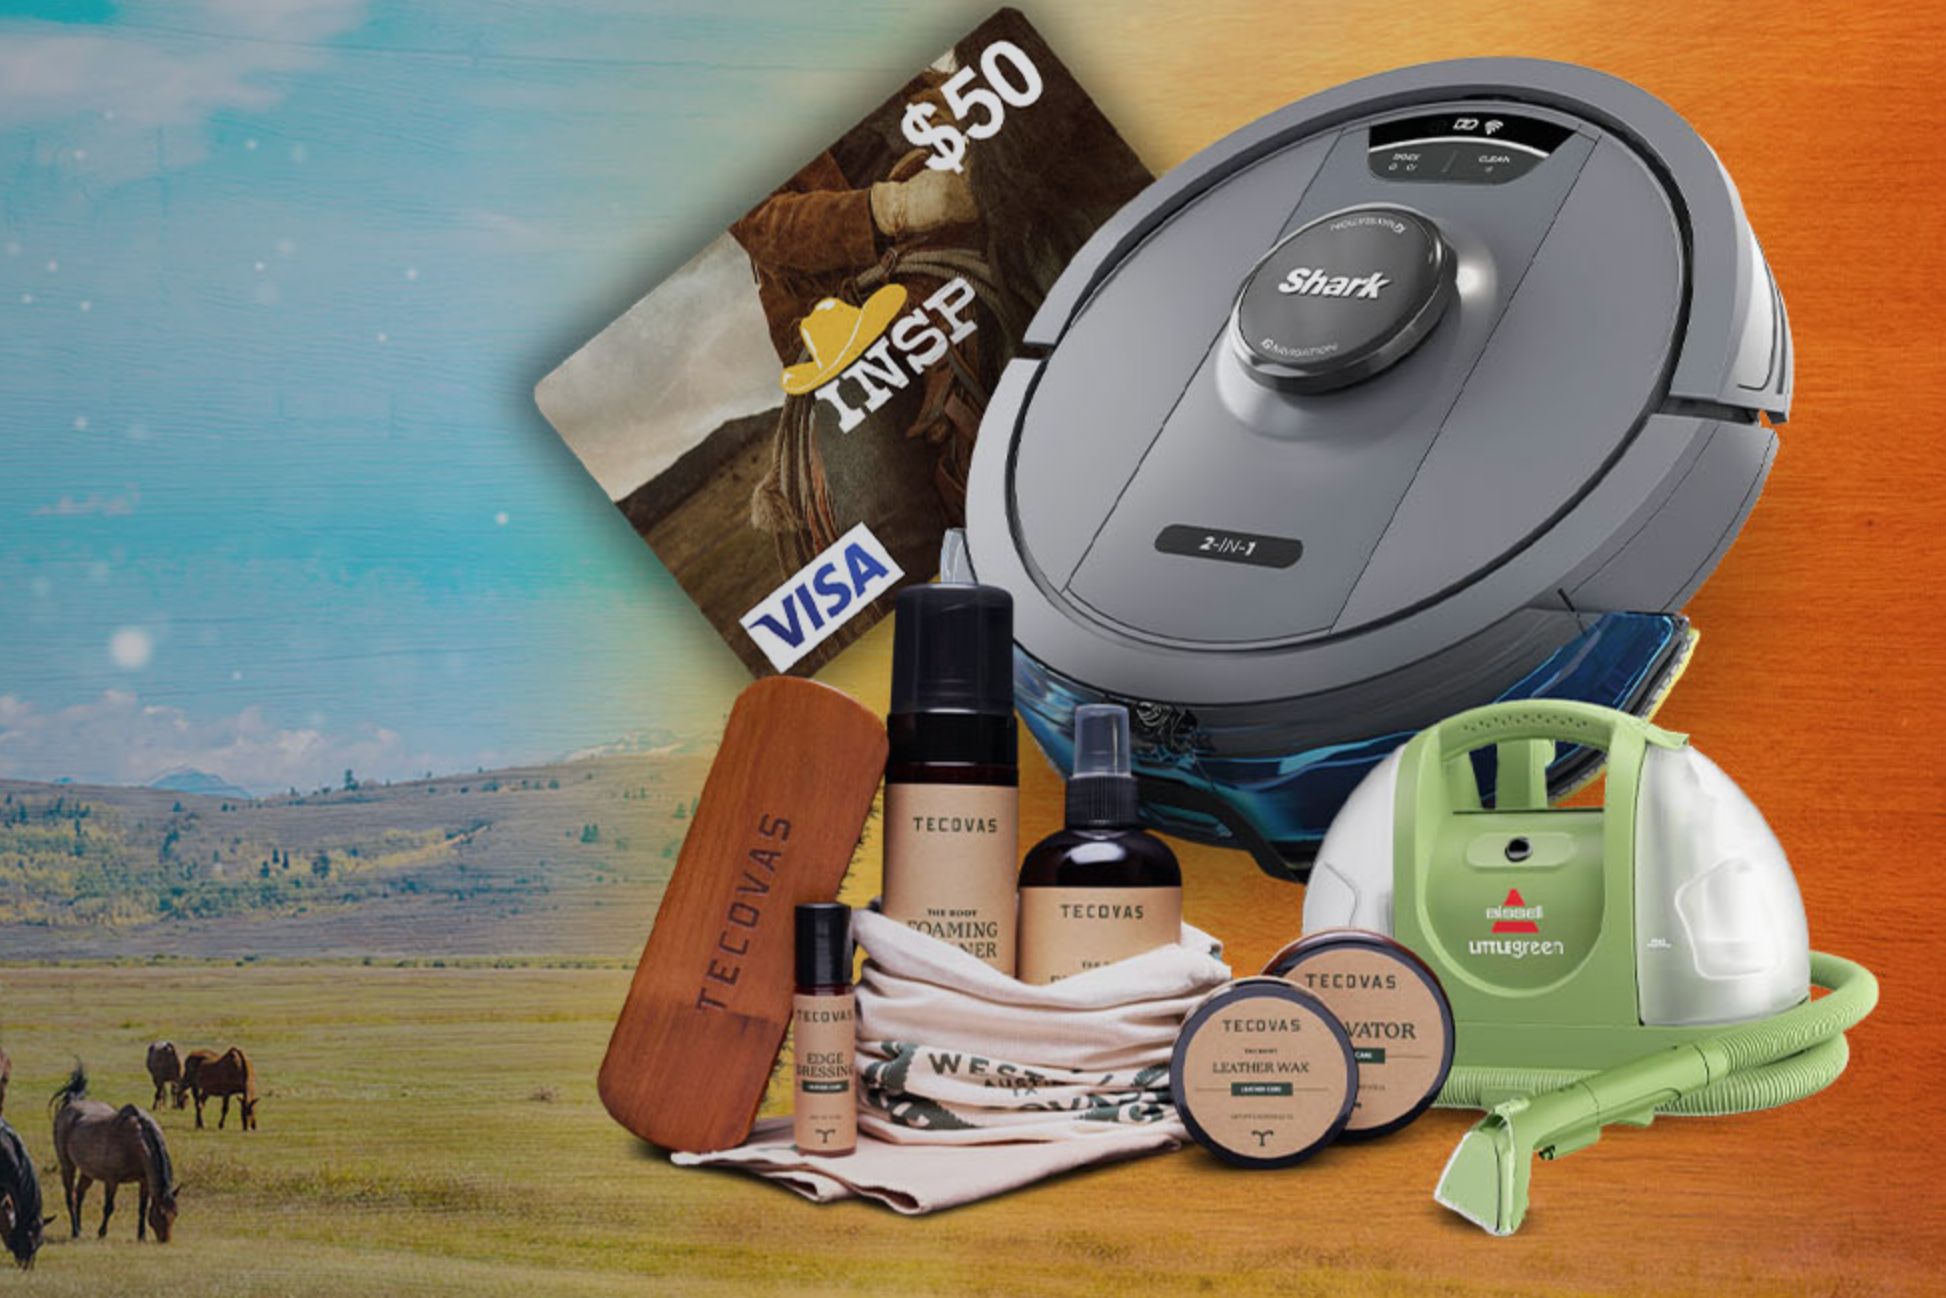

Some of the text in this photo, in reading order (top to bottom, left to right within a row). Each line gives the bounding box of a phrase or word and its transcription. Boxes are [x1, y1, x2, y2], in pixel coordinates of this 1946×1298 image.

[902, 40, 1043, 174] $50
[1278, 267, 1391, 298] Shark
[814, 277, 980, 434] INSP
[1199, 536, 1257, 556] 2-IN-1
[748, 542, 890, 649] VISA
[912, 816, 999, 833] TECOVAS
[695, 814, 792, 1011] TECOVAS
[927, 908, 945, 917] THE
[1060, 903, 1145, 919] TECOVAS
[1305, 973, 1397, 989] TECOVAS
[1222, 1019, 1302, 1032] TECOVAS
[1345, 1021, 1417, 1039] VATOR
[806, 1053, 845, 1065] EDGE
[1212, 1061, 1310, 1074] LEATHER WAX
